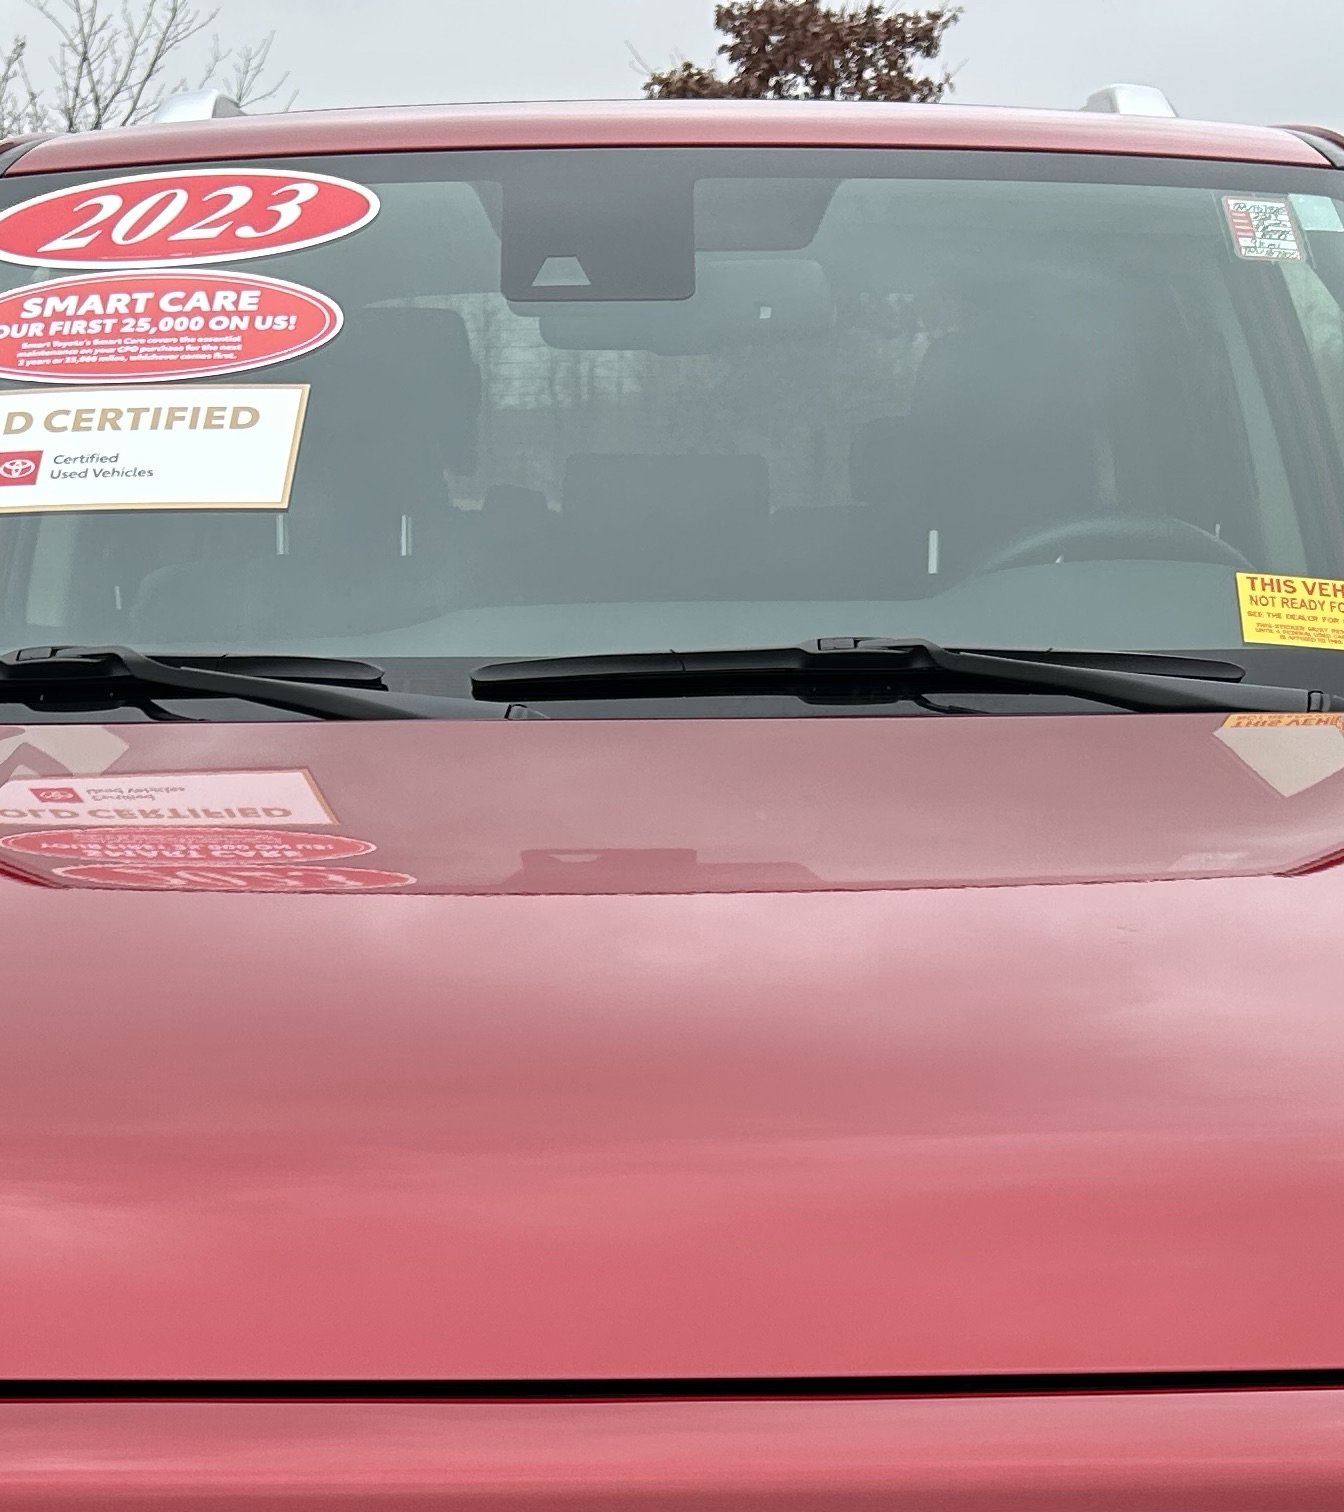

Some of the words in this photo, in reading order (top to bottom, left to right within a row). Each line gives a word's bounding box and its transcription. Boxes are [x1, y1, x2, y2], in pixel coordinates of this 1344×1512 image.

[37, 183, 319, 252] 2023
[20, 291, 155, 318] SMART
[159, 290, 262, 311] CARE
[48, 319, 117, 336] FIRST
[120, 317, 204, 336] 25,000
[208, 316, 250, 331] ON
[254, 315, 298, 330] US!
[43, 406, 260, 433] CERTIFIED
[53, 452, 120, 465] Certified
[50, 468, 87, 480] Used
[93, 466, 154, 479] Vehicles
[1246, 576, 1297, 594] THIS
[1248, 595, 1277, 607] NOT
[1281, 597, 1326, 612] READY
